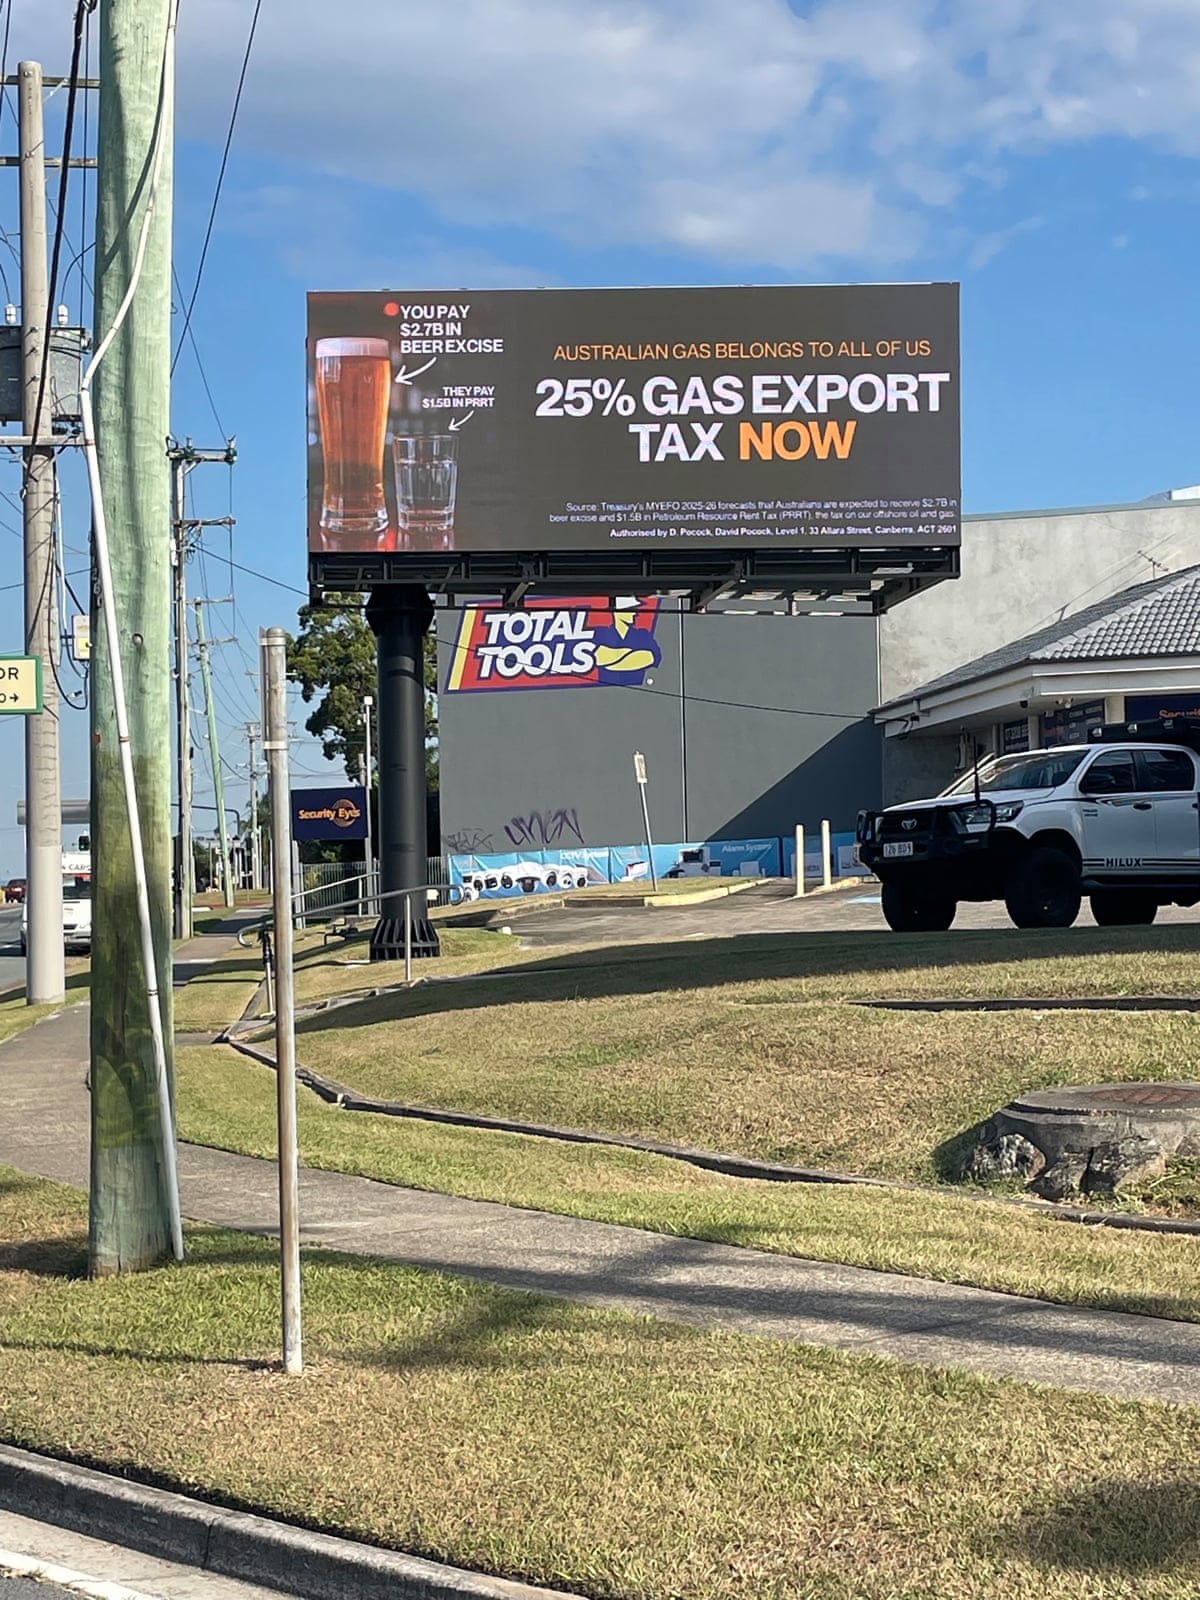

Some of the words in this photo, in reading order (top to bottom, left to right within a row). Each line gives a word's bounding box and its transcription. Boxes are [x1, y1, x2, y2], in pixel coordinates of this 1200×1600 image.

[400, 305, 435, 319] YOU
[437, 304, 470, 319] PAY
[400, 322, 444, 337] $2.7B
[446, 322, 462, 336] IN
[400, 340, 443, 353] BEER
[445, 339, 504, 353] EXCISE
[554, 344, 668, 360] AUSTRALIAN
[672, 343, 711, 359] GAS
[715, 342, 804, 359] BELONGS
[808, 341, 834, 358] TO
[838, 341, 872, 357] ALL
[876, 340, 901, 357] OF
[906, 340, 931, 356] US
[442, 386, 472, 396] THEY
[473, 386, 495, 396] PAY
[535, 378, 636, 417] 25%
[642, 375, 745, 416] GAS
[752, 373, 950, 414] EXPORT
[452, 398, 464, 407] IN
[465, 397, 495, 407] PRRT
[628, 422, 725, 462] TAX
[739, 420, 857, 461] NOW
[645, 501, 680, 510] MYEFO
[718, 500, 756, 509] forecasts
[758, 501, 774, 509] that
[775, 500, 822, 509] Australians
[839, 500, 878, 511] expected
[889, 500, 920, 508] receive
[949, 498, 957, 506] in
[549, 514, 568, 522] beer
[599, 513, 615, 522] and
[643, 513, 651, 521] in
[653, 512, 695, 521] Petroleum
[697, 511, 738, 520] Resource
[739, 511, 760, 520] Rent
[762, 511, 777, 519] Tax
[815, 511, 829, 519] the
[830, 511, 843, 519] tax
[844, 511, 856, 519] on
[873, 510, 907, 518] offshore
[909, 510, 919, 518] oil
[920, 510, 937, 518] and
[609, 528, 656, 537] Authorised
[657, 528, 668, 538] by
[715, 527, 739, 536] David
[775, 527, 798, 535] Level
[820, 526, 845, 535] Allara
[917, 525, 936, 533] ACT
[485, 611, 595, 644] TOTAL
[477, 641, 596, 678] TOOLS
[298, 808, 336, 821] Security
[338, 807, 361, 820] Eyes
[1105, 857, 1142, 867] HILUX
